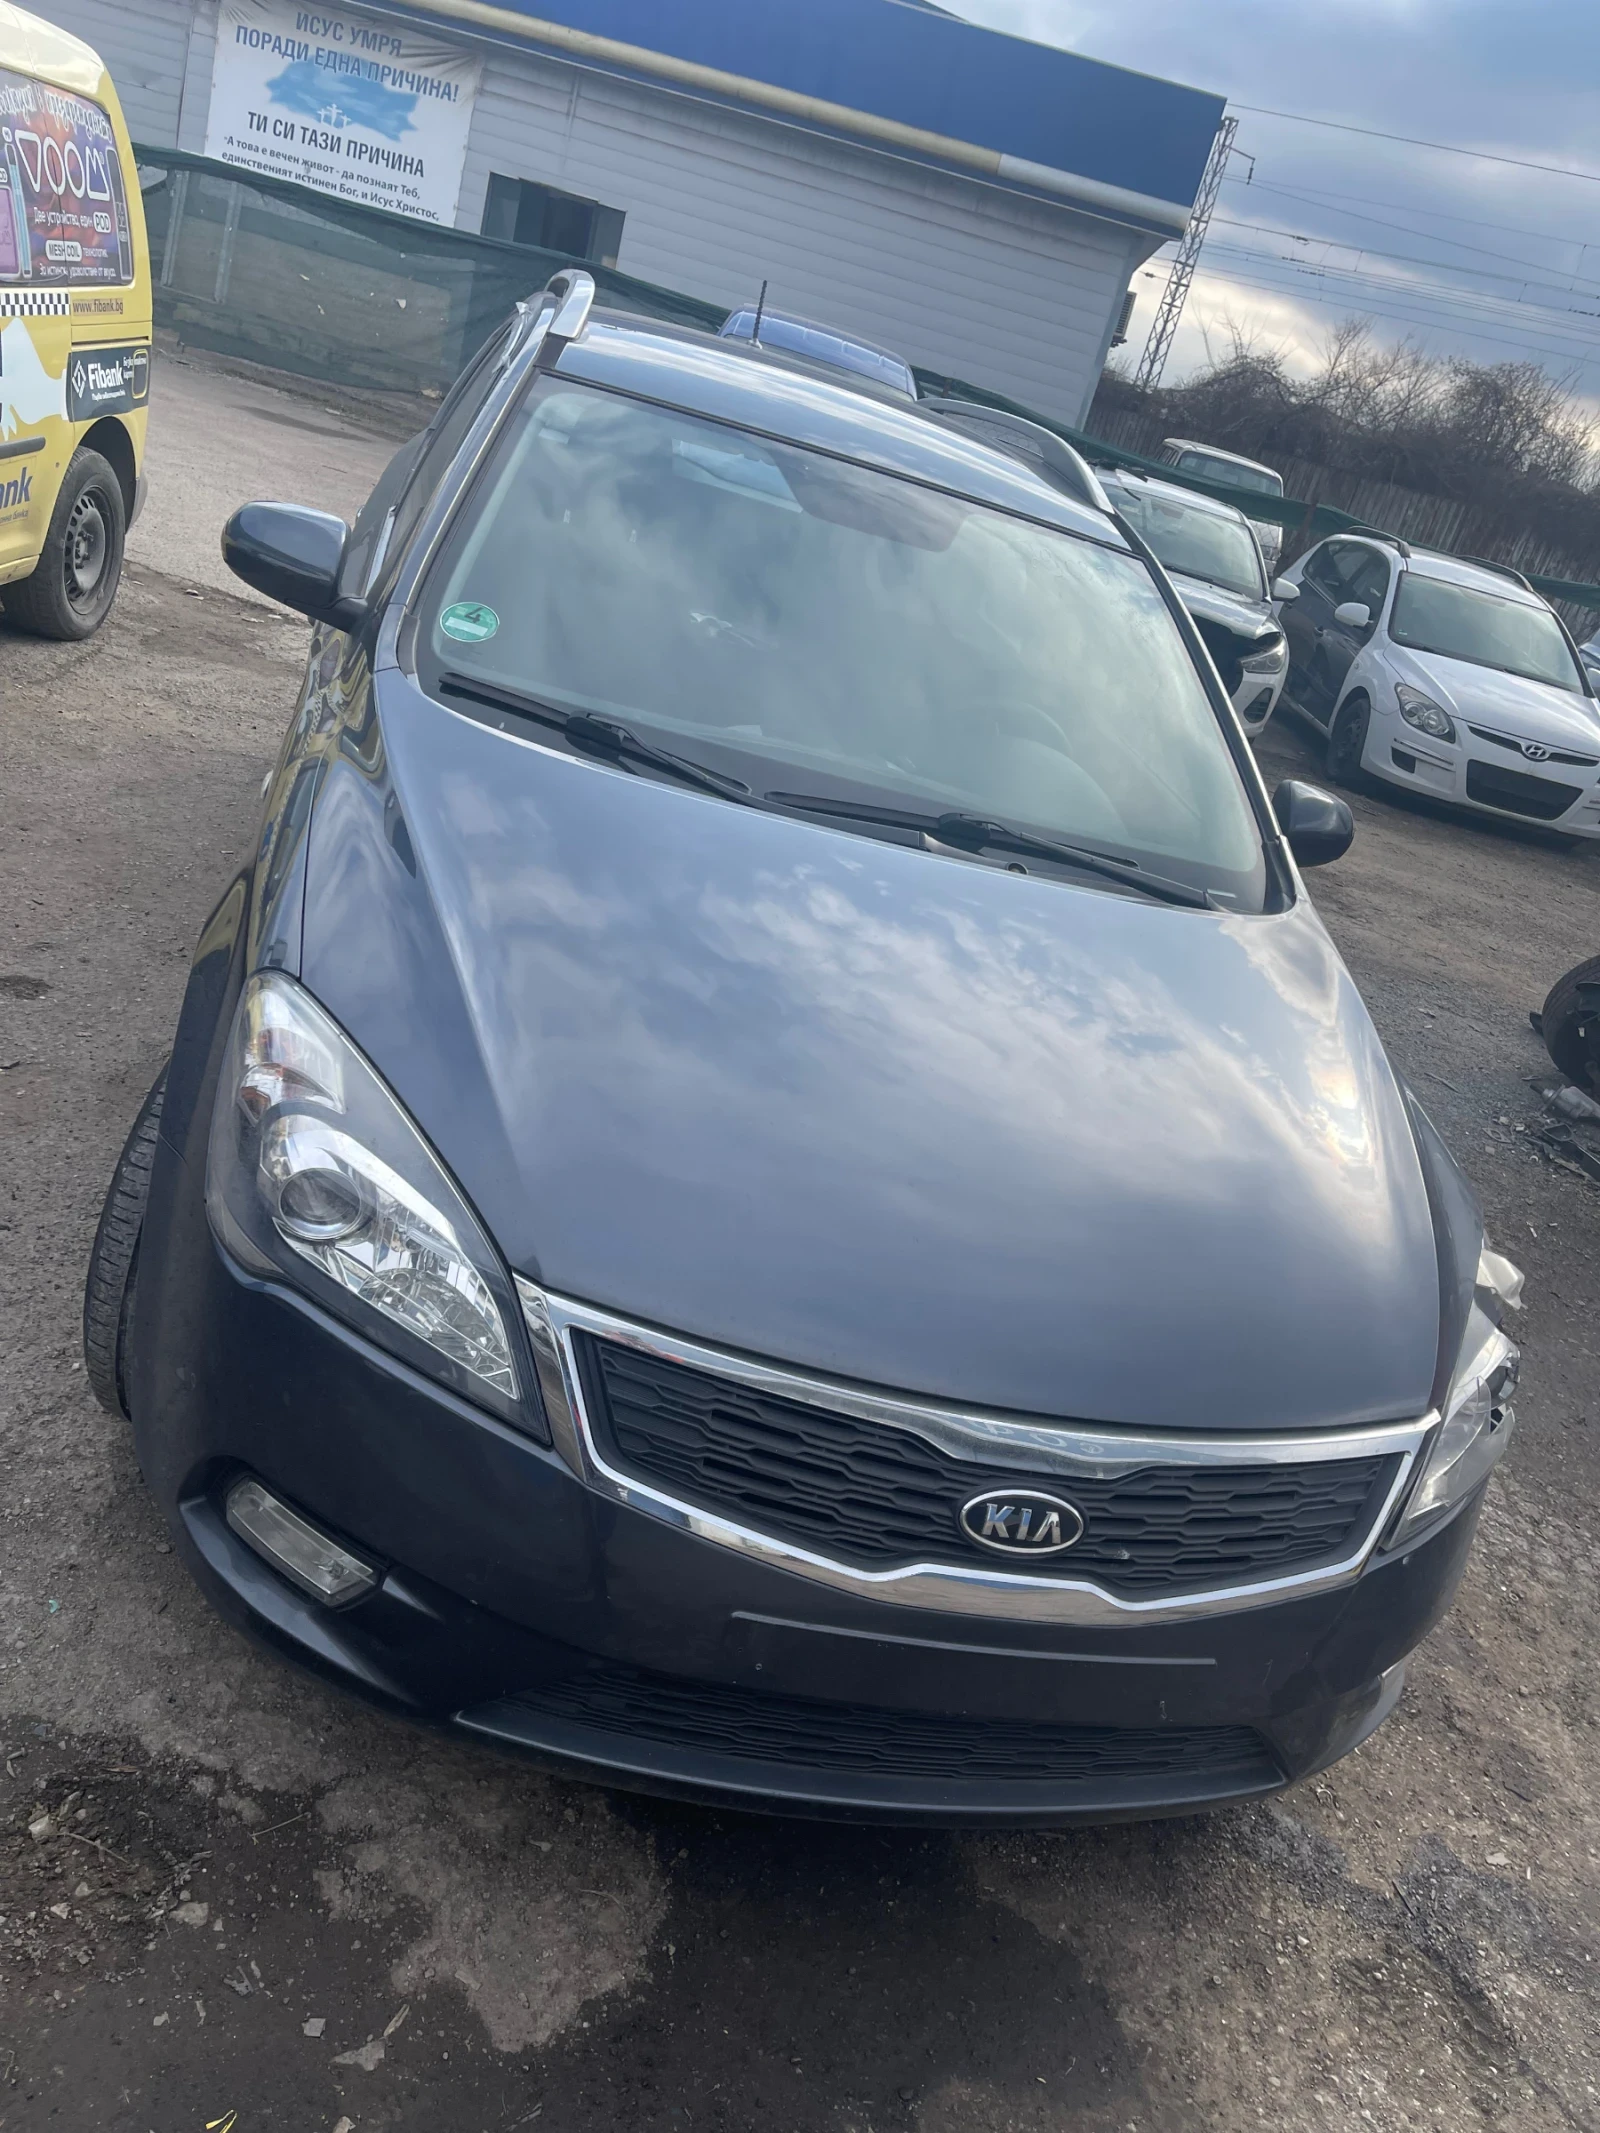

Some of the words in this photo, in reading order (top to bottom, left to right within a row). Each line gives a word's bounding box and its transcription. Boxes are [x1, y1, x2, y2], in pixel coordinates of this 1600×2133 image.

[296, 12, 344, 41] ИСУС
[350, 27, 402, 57] УМРЯ
[236, 25, 309, 62] ПОРАДИ
[315, 47, 361, 77] ЕДНА
[367, 62, 459, 102] ПРИЧИНА!
[248, 111, 268, 133] ТИ
[273, 118, 295, 141] СИ
[300, 126, 342, 154] ТАЗИ
[346, 139, 424, 178] ПРИЧИНА
[222, 151, 292, 179] единственият
[295, 172, 337, 192] истинен
[339, 183, 359, 199] Бог,
[361, 190, 368, 200] и
[370, 192, 394, 209] Исус
[396, 199, 440, 221] Христос,
[237, 140, 259, 153] това
[261, 147, 268, 155] е
[269, 149, 299, 165] вечен
[301, 156, 334, 175] живот
[341, 169, 354, 182] да
[356, 174, 398, 193] познаят
[401, 184, 420, 200] Теб,
[95, 214, 110, 231] POD
[73, 299, 124, 314] www.fibank.bg
[88, 361, 124, 390] Fibank
[981, 1502, 1061, 1544] KIA
